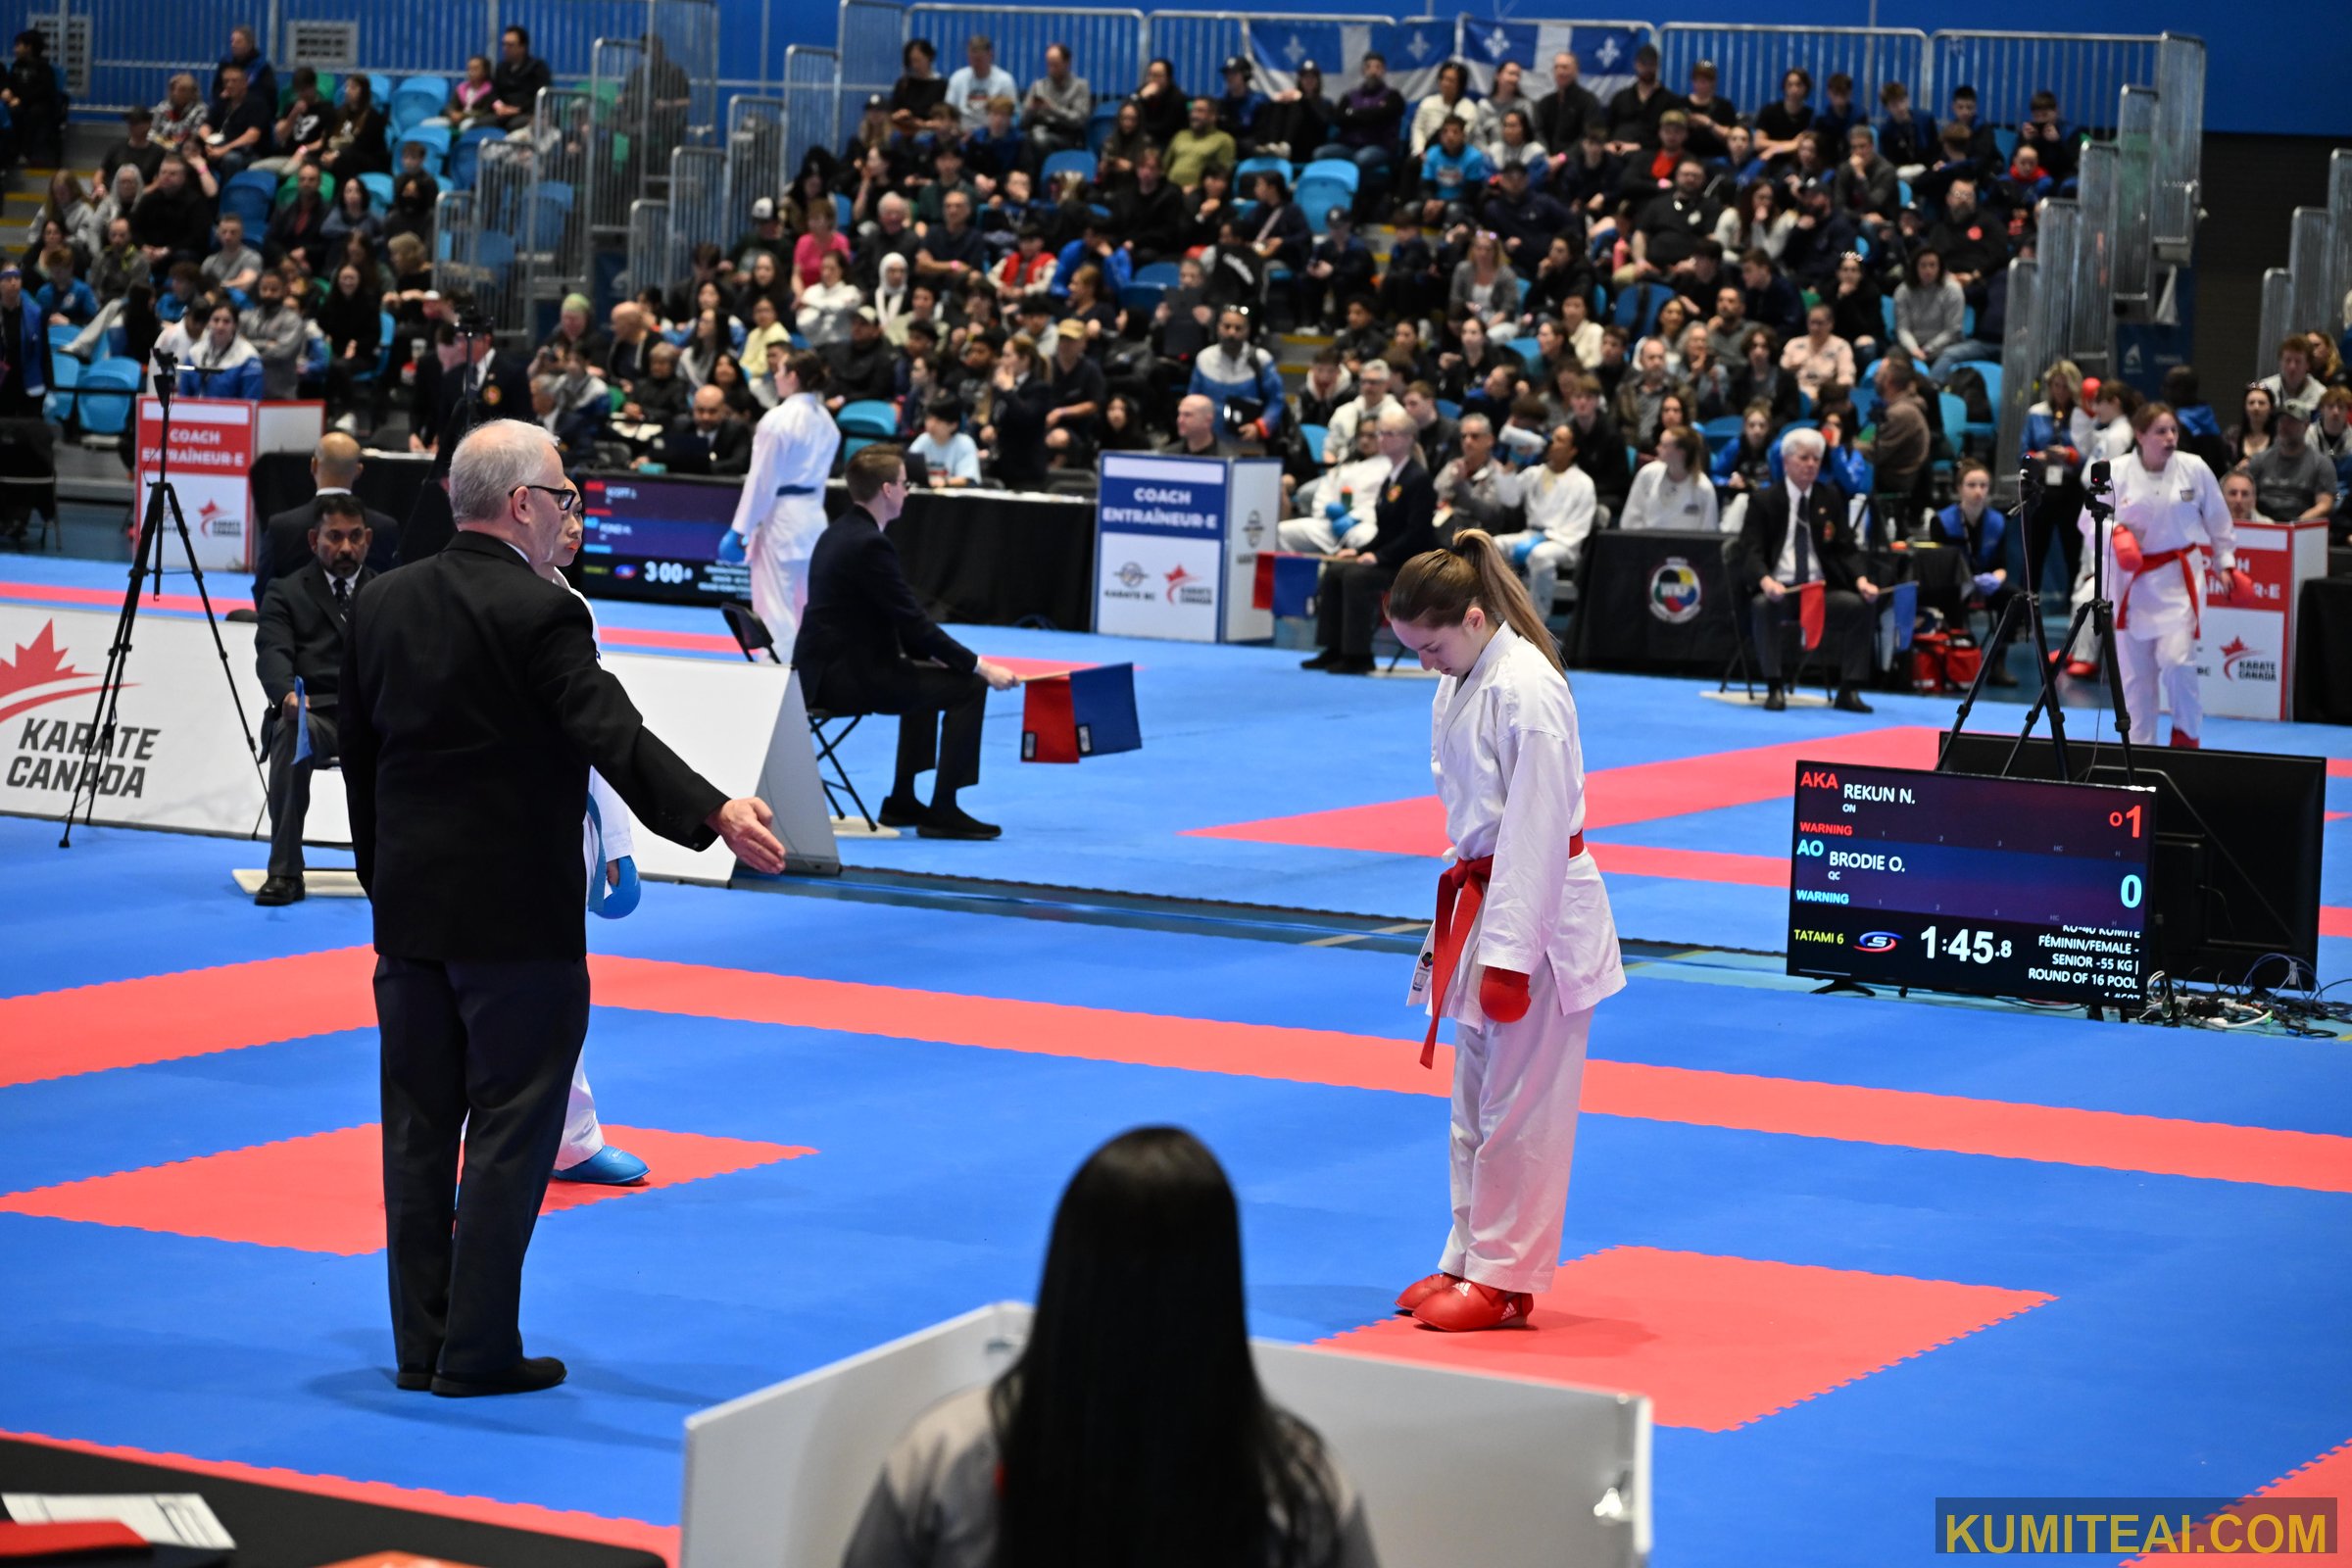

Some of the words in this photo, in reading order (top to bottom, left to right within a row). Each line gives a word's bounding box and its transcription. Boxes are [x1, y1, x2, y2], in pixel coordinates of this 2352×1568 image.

[170, 428, 220, 445] COACH
[1134, 488, 1192, 505] COACH
[2238, 661, 2276, 670] KARATE
[2238, 670, 2277, 681] CANADA
[1800, 771, 1838, 790] AKA
[1843, 783, 1895, 803] REKUN
[1899, 788, 1916, 805] N.
[1842, 804, 1856, 813] ON
[1799, 821, 1853, 836] WARNING
[1796, 839, 1824, 857] AO
[1829, 851, 1886, 871] BRODIE
[1888, 856, 1906, 872] O.
[1828, 870, 1840, 881] QC
[1795, 890, 1849, 905] WARNING
[2120, 874, 2142, 908] 0
[1794, 929, 1835, 944] TATAMI
[1837, 933, 1844, 945] 6
[1920, 925, 2013, 964] 1:45.8
[2038, 933, 2132, 955] FÉMININ/FEMALE
[2051, 954, 2094, 967] SENIOR
[2095, 957, 2115, 970] -55
[2117, 959, 2133, 972] KG
[2028, 967, 2071, 983] ROUND
[2072, 972, 2089, 985] OF
[2091, 974, 2105, 987] 16
[2107, 975, 2139, 990] POOL
